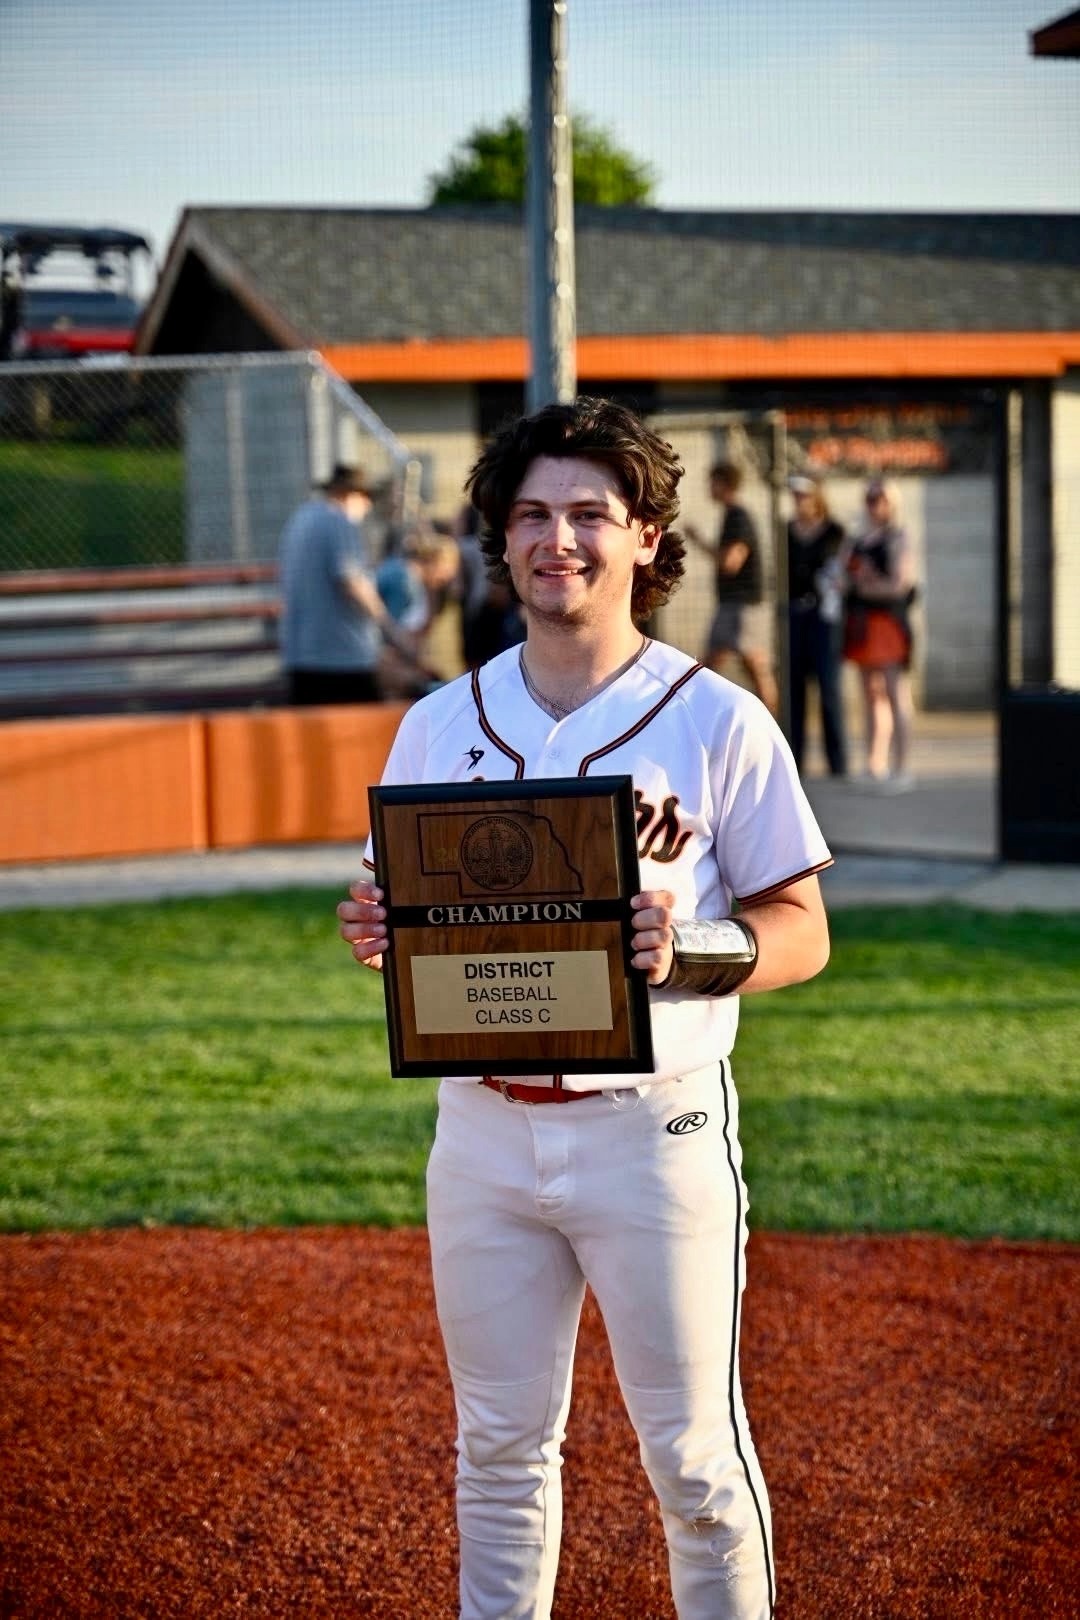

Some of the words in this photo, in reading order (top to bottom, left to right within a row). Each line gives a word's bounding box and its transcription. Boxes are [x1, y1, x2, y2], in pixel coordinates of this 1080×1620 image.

[427, 903, 583, 925] CHAMPION
[464, 961, 555, 979] DISTRICT
[467, 986, 558, 1003] BASEBALL
[475, 1008, 533, 1025] CLASS
[538, 1008, 551, 1024] C
